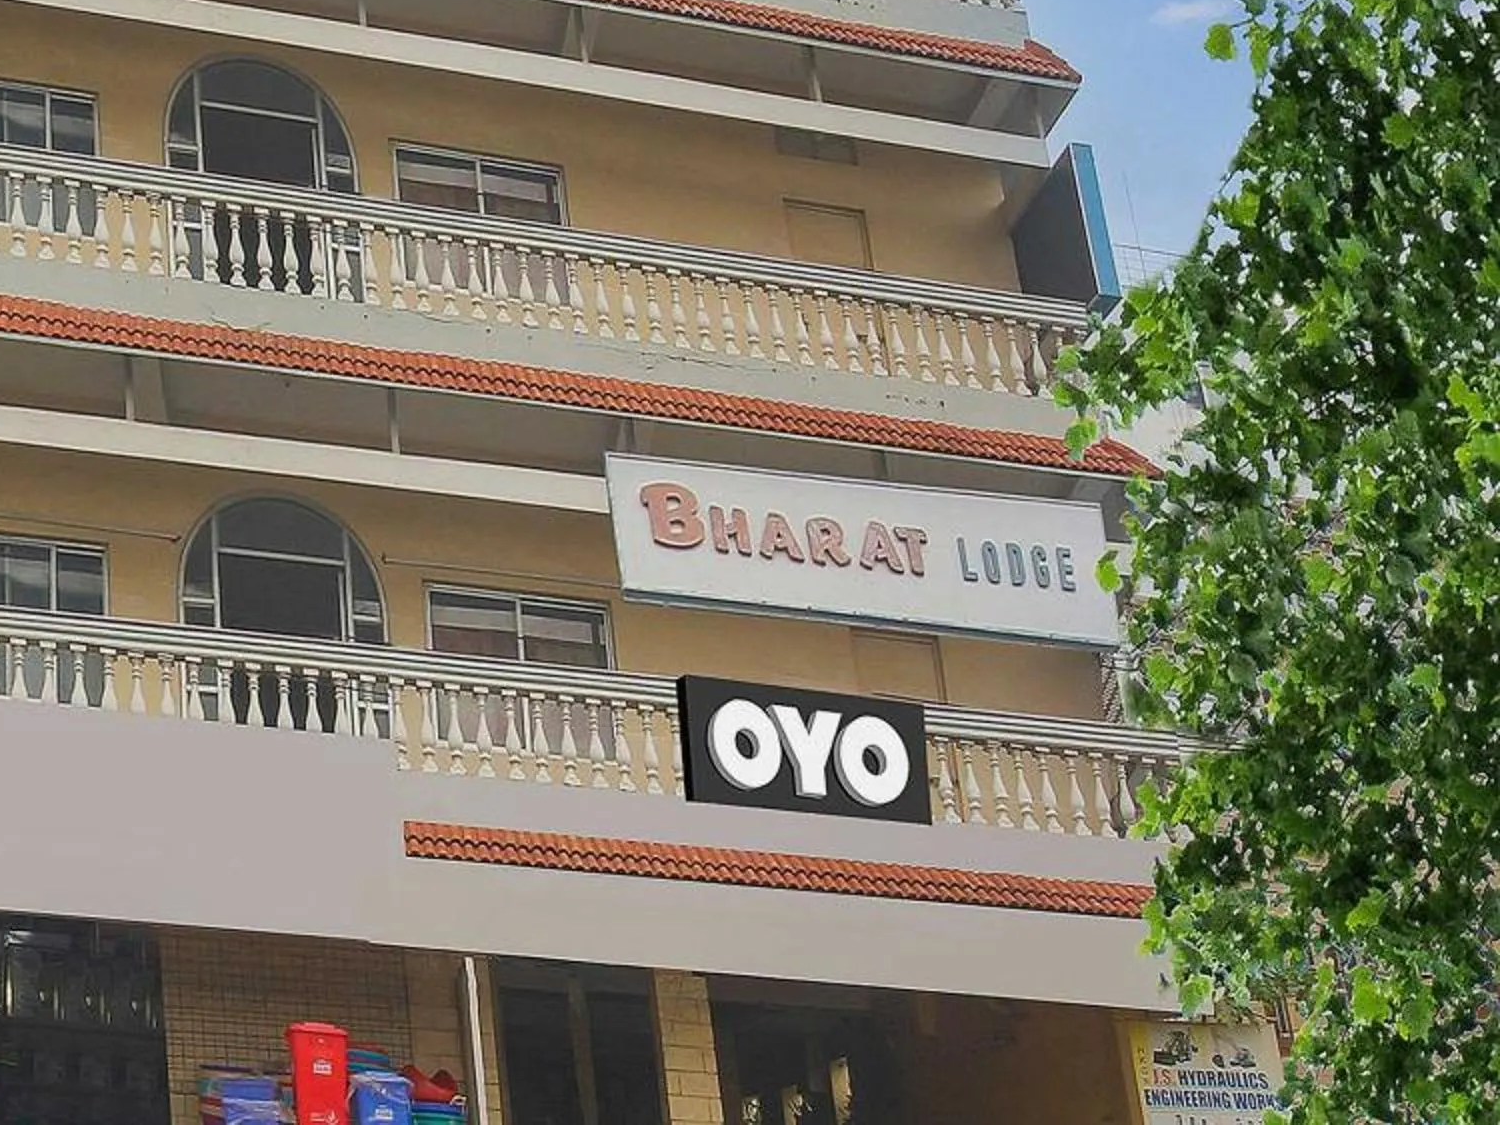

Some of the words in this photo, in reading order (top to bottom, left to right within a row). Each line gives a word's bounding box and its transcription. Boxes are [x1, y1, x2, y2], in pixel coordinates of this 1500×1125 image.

[956, 536, 1078, 592] LODGE
[706, 697, 911, 807] OYO
[1144, 1087, 1231, 1109] ENGINEERING
[1177, 1068, 1269, 1089] HYDRAULICS
